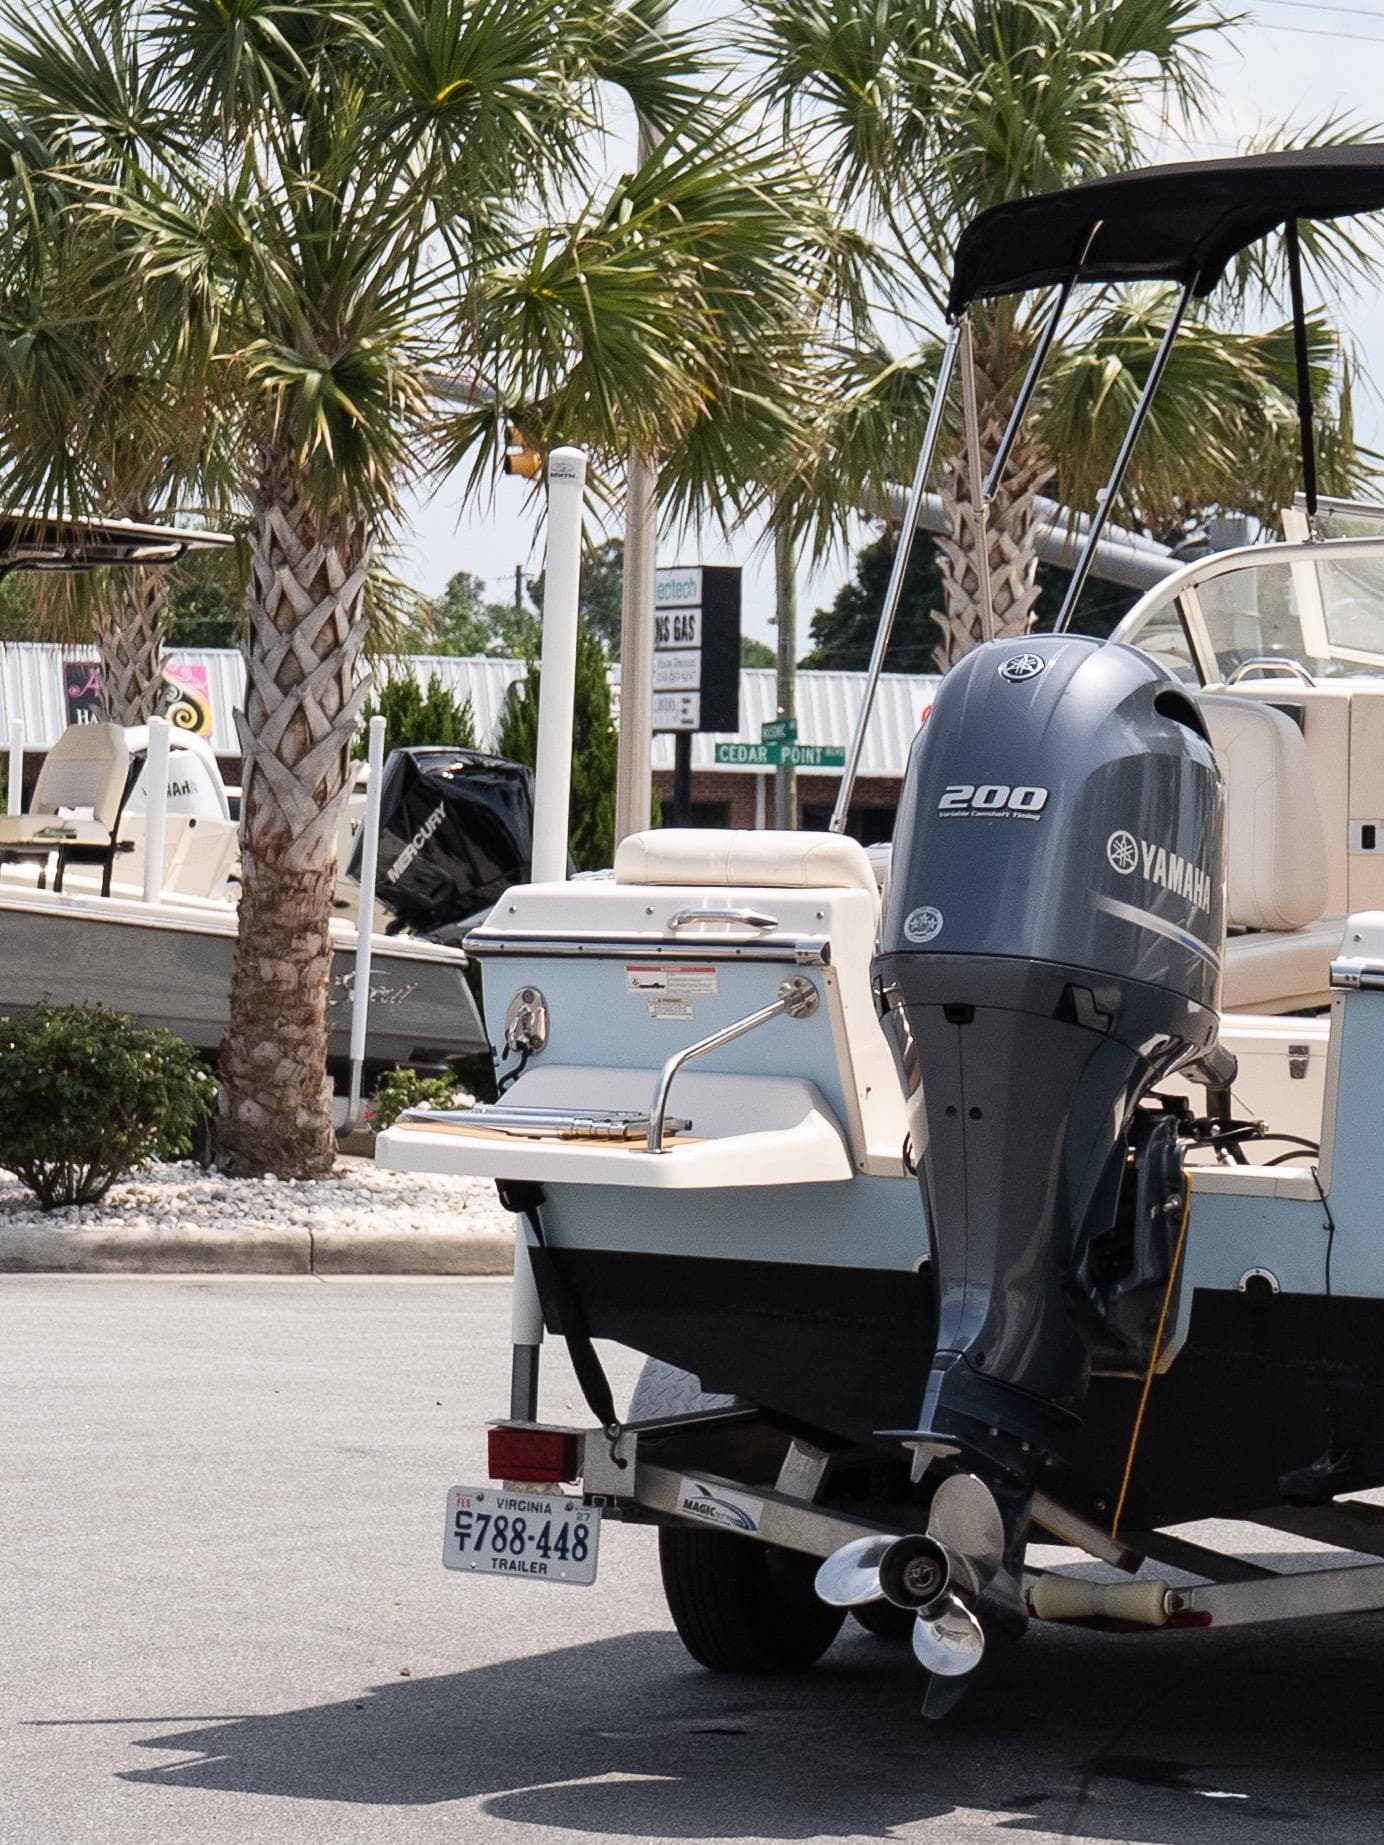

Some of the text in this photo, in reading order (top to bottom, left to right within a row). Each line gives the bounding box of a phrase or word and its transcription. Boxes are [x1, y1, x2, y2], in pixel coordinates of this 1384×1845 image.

[673, 614, 695, 642] GAS
[720, 745, 768, 762] CEDAR
[781, 746, 822, 764] POINT
[938, 785, 1048, 811] 200
[387, 800, 446, 884] MERCURY
[1141, 839, 1210, 915] YAMAHA
[497, 1498, 552, 1514] VIRGINIA
[576, 1512, 591, 1522] 27
[683, 1498, 716, 1517] MAGIC
[473, 1513, 589, 1562] 788-448
[491, 1557, 548, 1575] TRAILER
